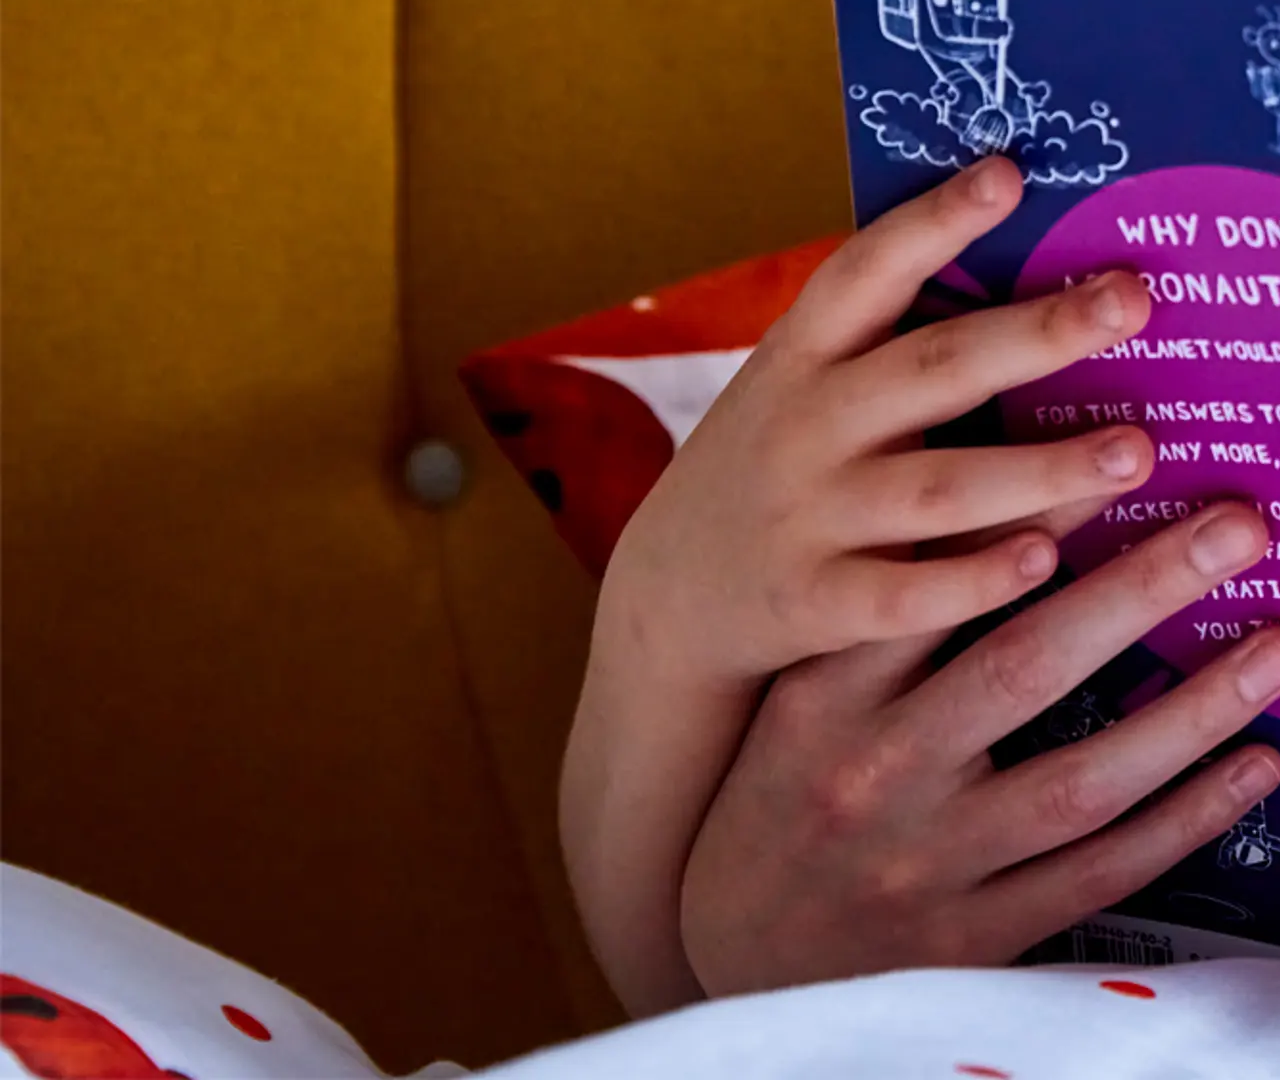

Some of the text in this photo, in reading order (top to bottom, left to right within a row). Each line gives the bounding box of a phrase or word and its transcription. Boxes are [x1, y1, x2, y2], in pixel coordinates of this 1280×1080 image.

[1116, 213, 1199, 247] WHY
[1131, 338, 1210, 360] PLANET
[1035, 405, 1079, 426] FOR
[1085, 401, 1137, 423] THE
[1144, 400, 1255, 425] ANSWERS
[1155, 440, 1202, 463] ANY
[1103, 499, 1190, 524] PACKED
[1193, 621, 1242, 642] YOU
